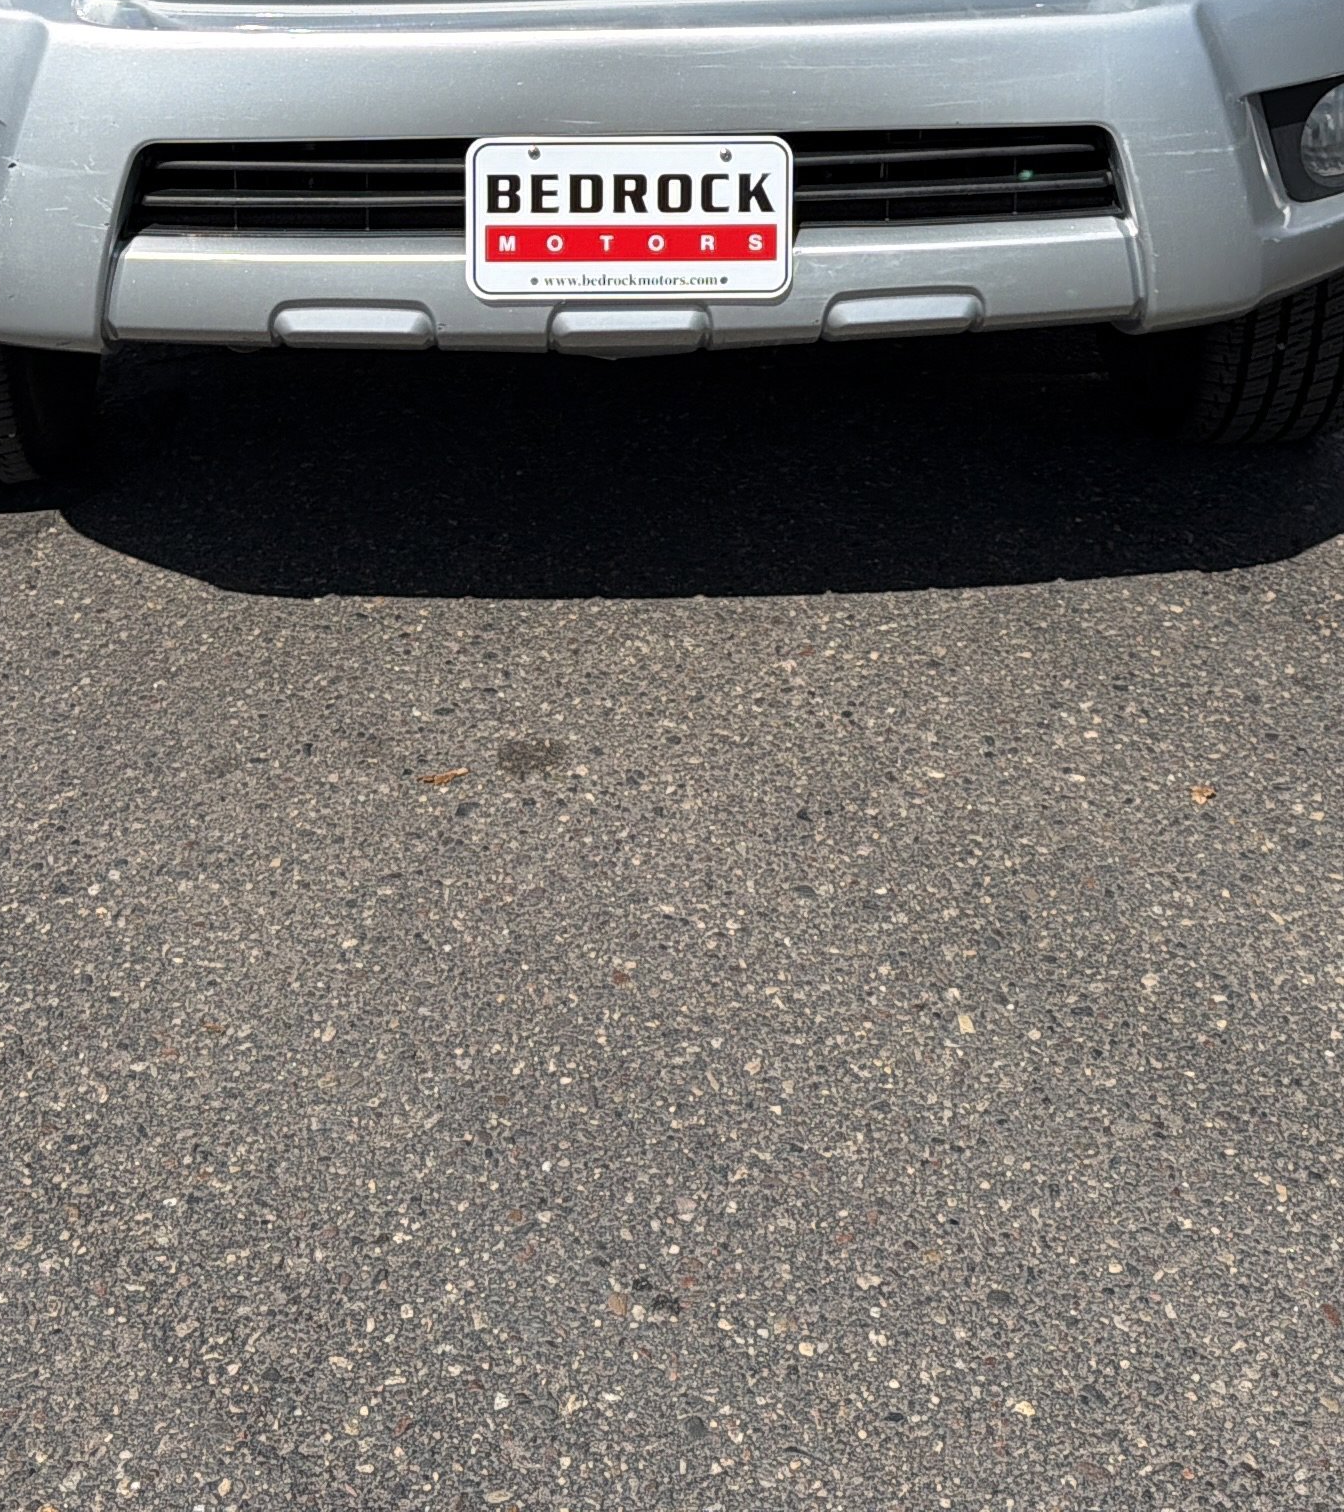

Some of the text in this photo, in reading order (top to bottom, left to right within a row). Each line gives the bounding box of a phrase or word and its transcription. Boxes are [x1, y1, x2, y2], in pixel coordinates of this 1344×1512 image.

[486, 173, 775, 213] BEDROCK
[498, 234, 764, 253] MOTORS
[544, 273, 718, 287] www.bedrockmotors.com
